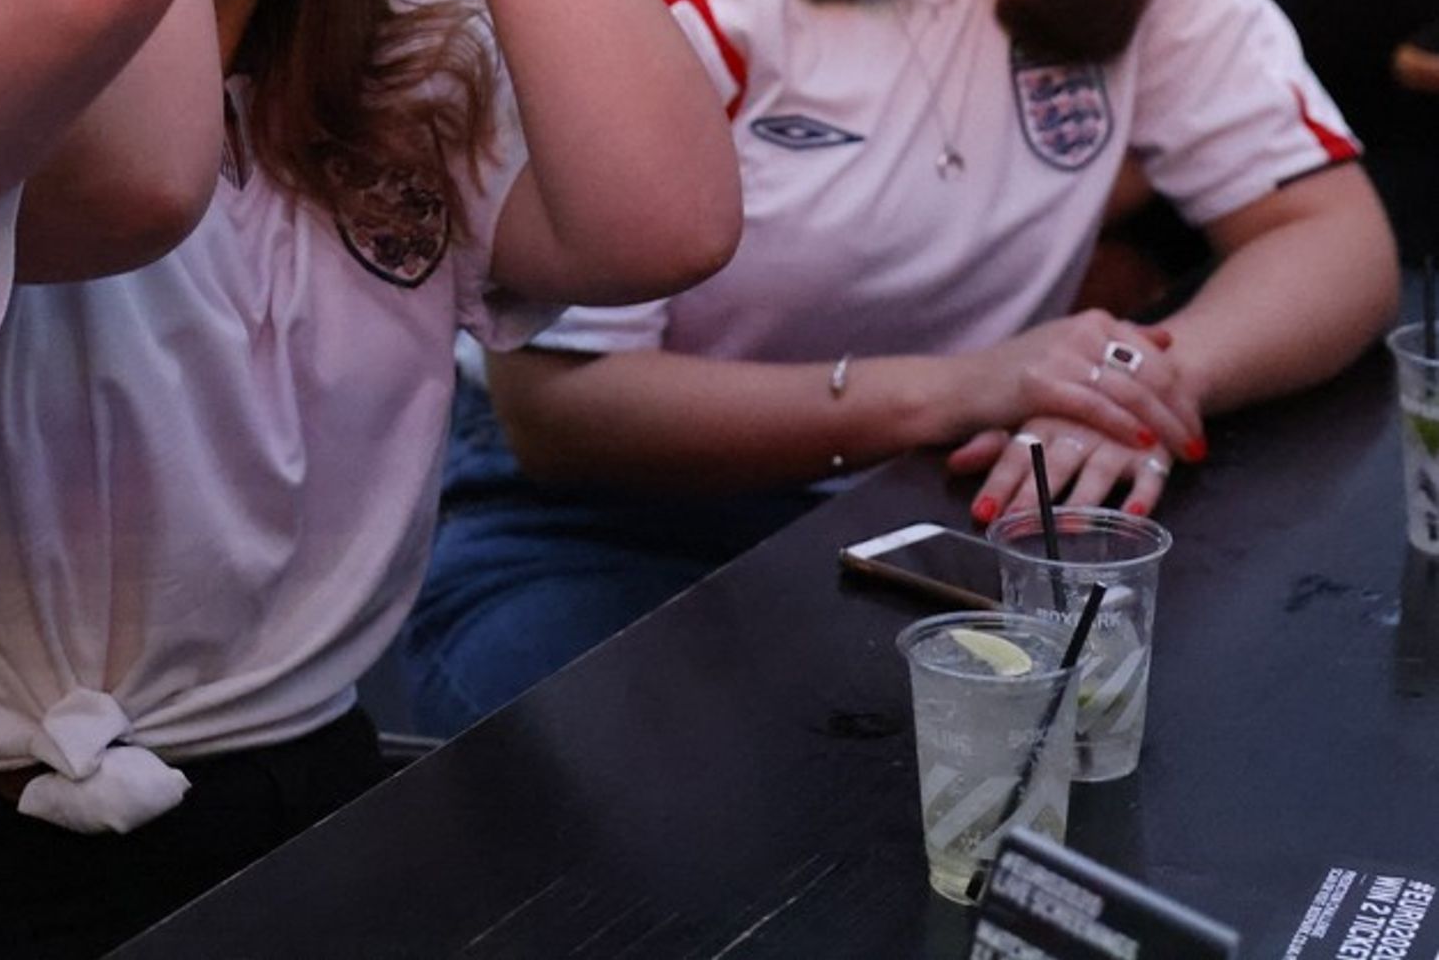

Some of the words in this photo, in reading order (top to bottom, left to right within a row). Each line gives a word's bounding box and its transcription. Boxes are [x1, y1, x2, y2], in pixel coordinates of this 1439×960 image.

[1036, 607, 1123, 630] BOXRK
[1366, 875, 1406, 903] WIN
[1360, 902, 1392, 916] 2
